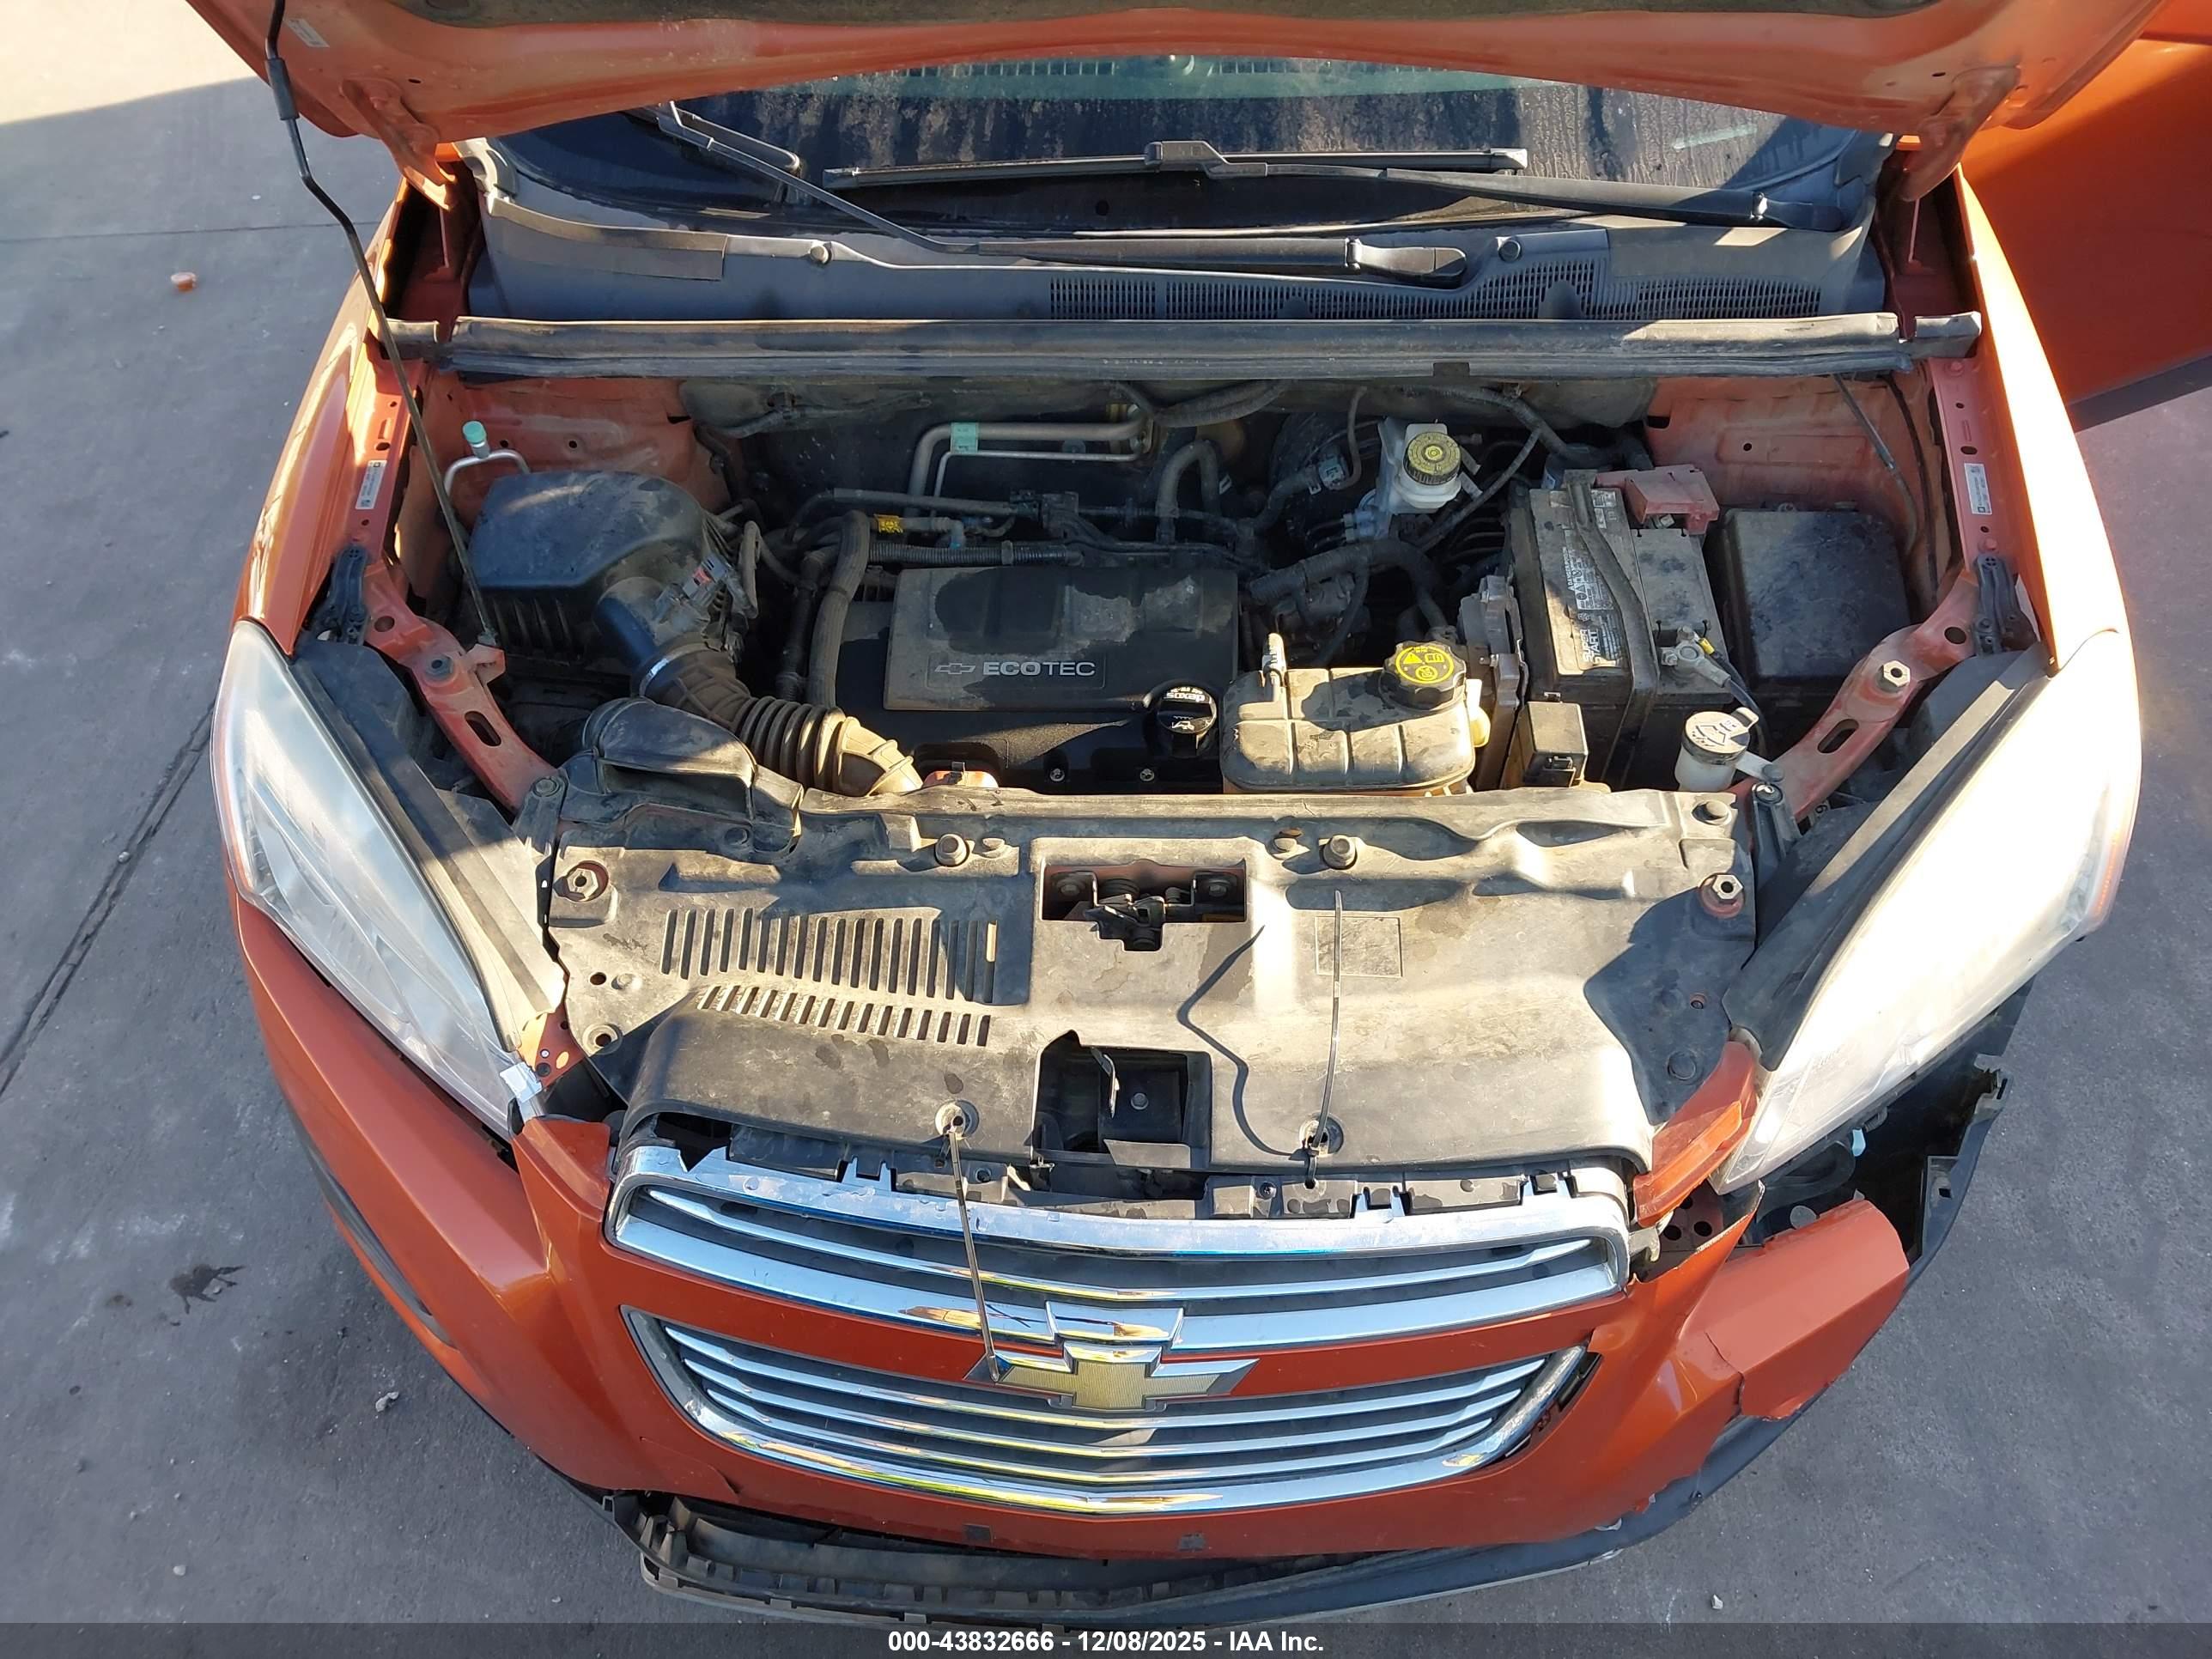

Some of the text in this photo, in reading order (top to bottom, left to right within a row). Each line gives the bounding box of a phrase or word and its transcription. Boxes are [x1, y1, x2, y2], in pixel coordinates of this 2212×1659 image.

[1579, 629, 1594, 662] SUPER
[982, 661, 1096, 676] ECOTEC
[1164, 692, 1206, 702] dexos
